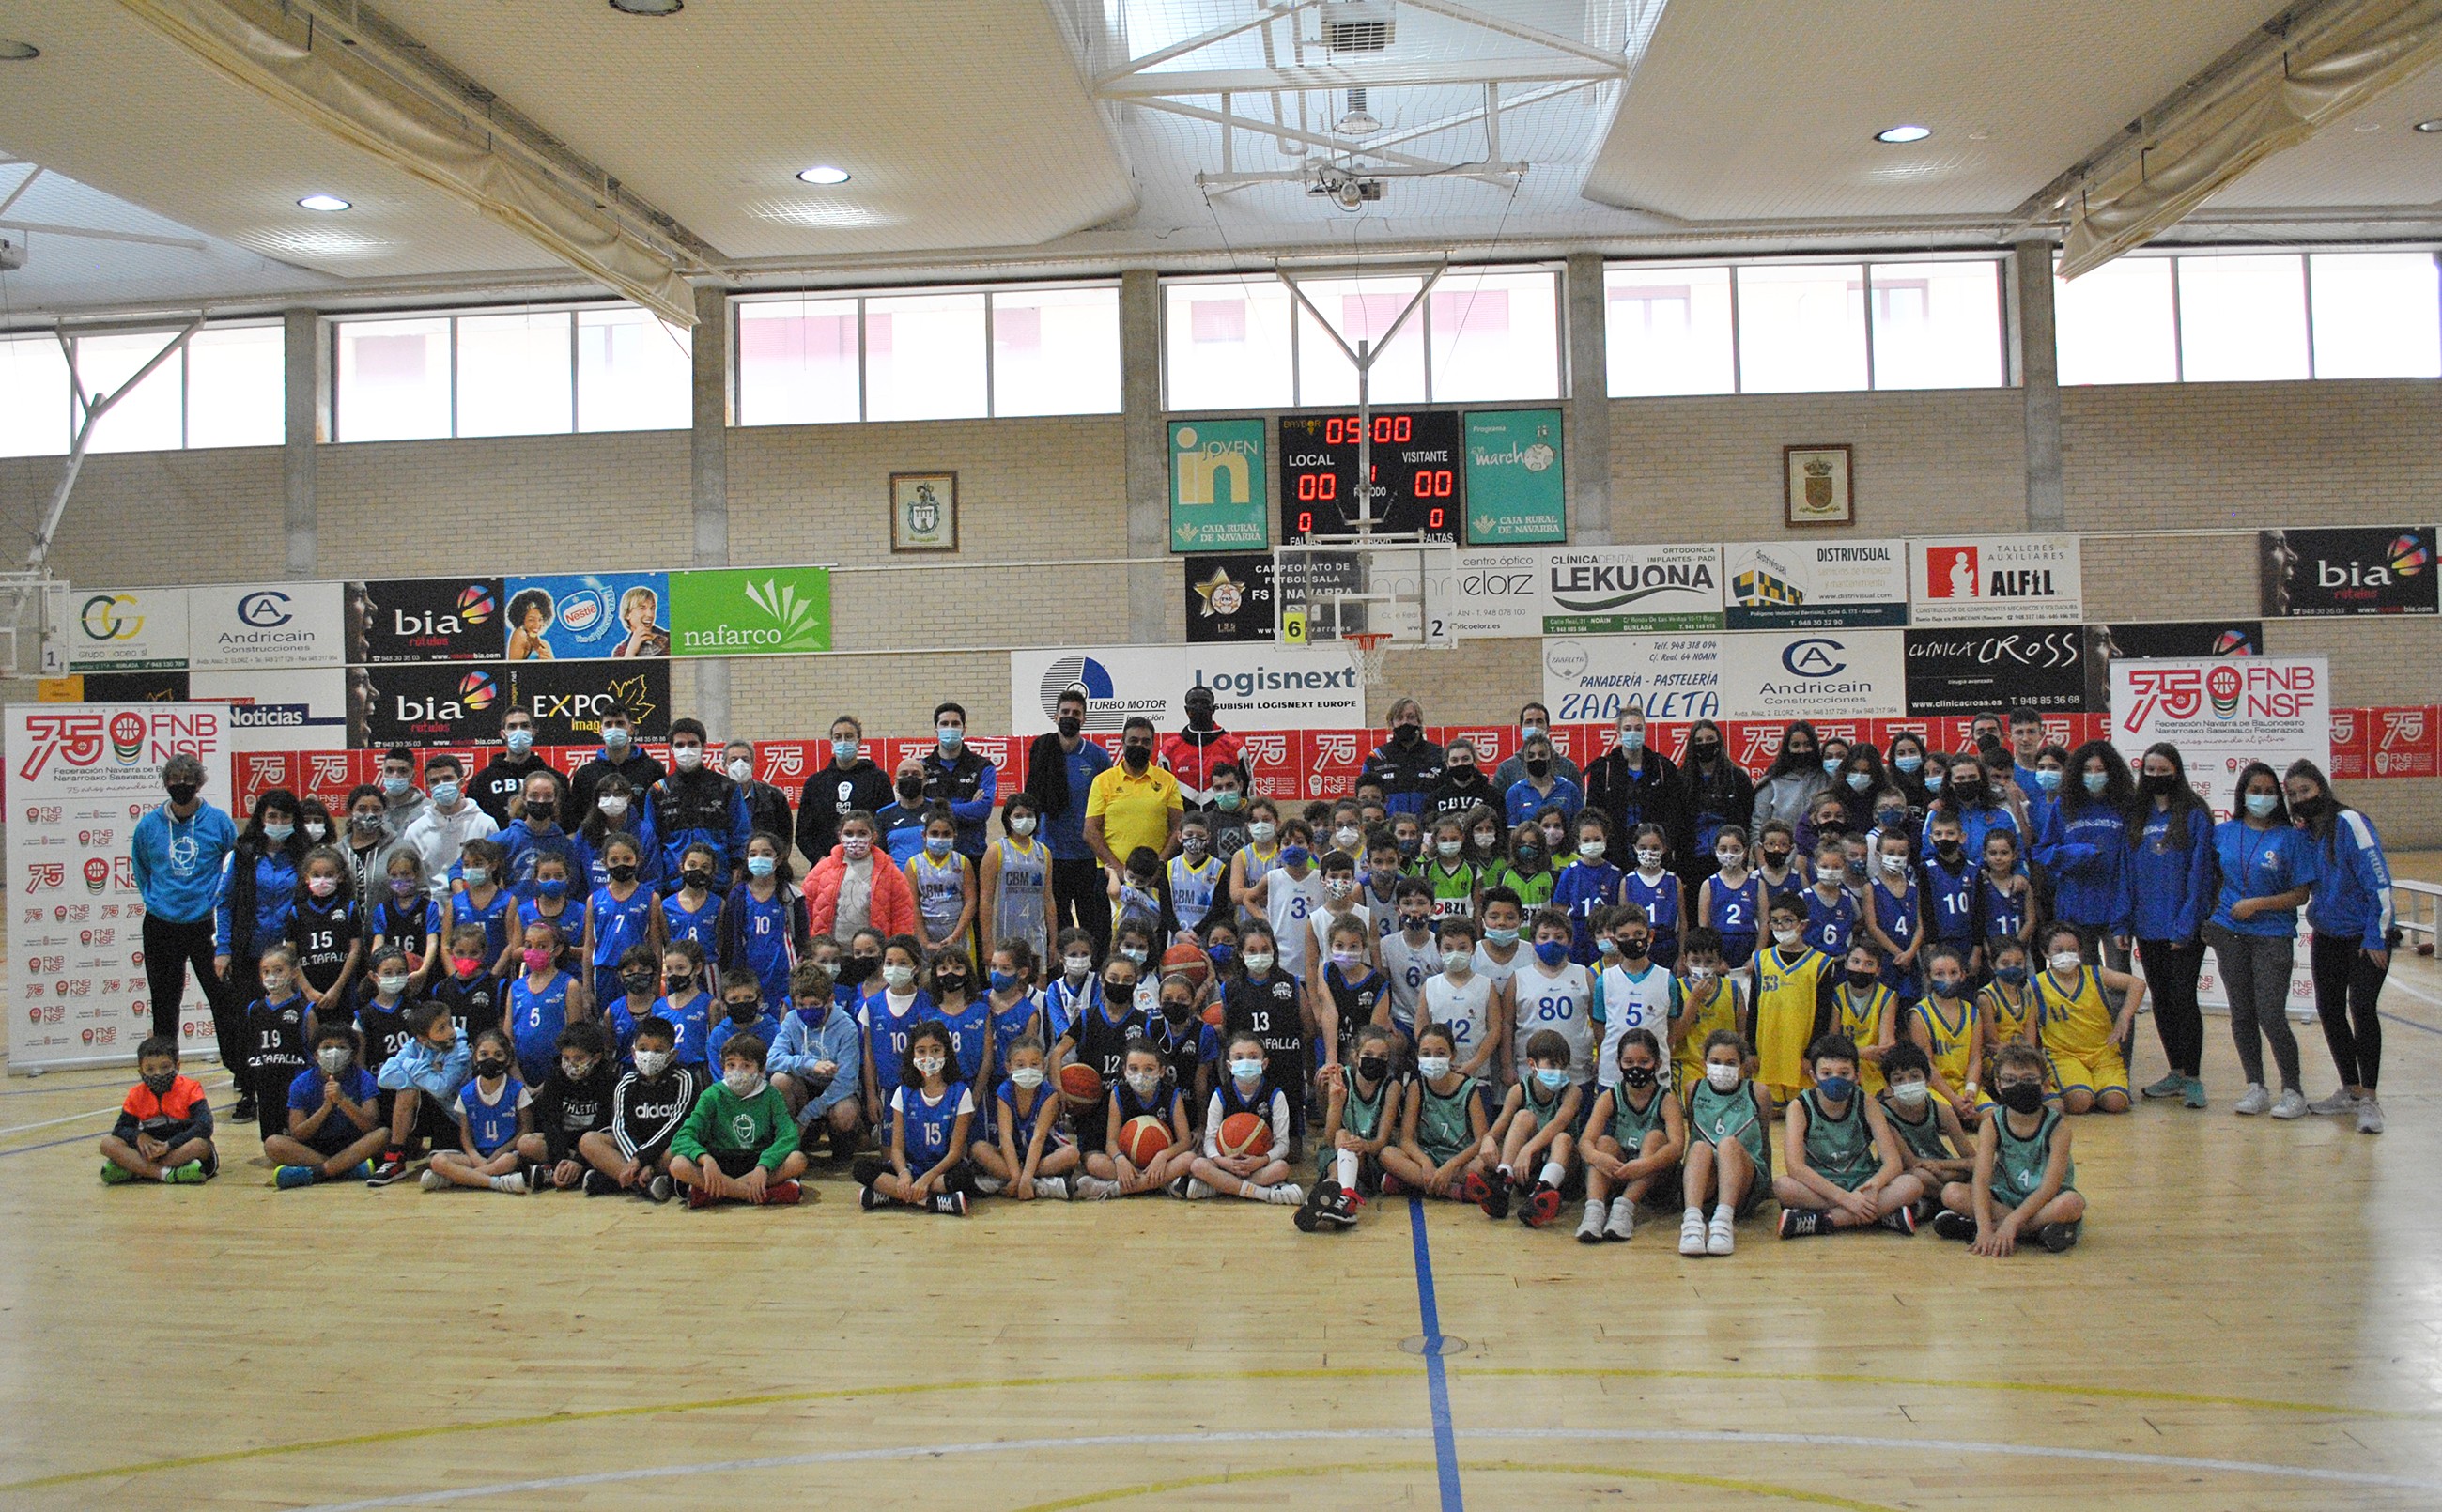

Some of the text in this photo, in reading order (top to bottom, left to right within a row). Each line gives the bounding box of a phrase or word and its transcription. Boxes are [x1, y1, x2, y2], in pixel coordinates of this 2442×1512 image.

[1473, 425, 1507, 434] Programa
[1203, 440, 1258, 461] JOVEN
[1402, 451, 1448, 463] VISITANTE
[1289, 455, 1335, 467] LOCAL
[1298, 473, 1337, 501] 00
[1414, 471, 1453, 498] 00
[1298, 512, 1312, 532] 0
[1430, 508, 1444, 528] 0
[1500, 517, 1522, 525] CAJA
[1200, 532, 1261, 542] DE NAVARRA
[1228, 524, 1260, 532] RURAL
[1515, 525, 1560, 533] NAVARRA
[1462, 556, 1533, 568] centro óptico
[1817, 548, 1890, 562] DISTRIVISUAL
[1988, 552, 2063, 561] AUXILIARES
[1463, 570, 1534, 595] elorz
[1551, 564, 1715, 593] LEKUONA
[2318, 560, 2393, 587] bia
[1252, 590, 1269, 600] FS
[395, 609, 463, 636] bia
[1288, 621, 1301, 637] 6
[1431, 619, 1444, 636] 2
[218, 630, 315, 643] Andricain
[684, 624, 781, 646] nafarco
[79, 650, 105, 659] Grupo
[223, 645, 310, 654] Construcciones
[47, 652, 56, 667] 1
[1196, 667, 1355, 697] Logisnext
[1579, 671, 1718, 687] PANADERÍA PASTELERÍA
[1759, 681, 1871, 694] Andricain
[2247, 667, 2315, 691] FNB
[397, 695, 465, 721] bia
[1090, 700, 1167, 710] TURBO MOTOR
[1558, 691, 1719, 720] ZABALETA
[1764, 696, 1866, 704] Construcciones
[1912, 700, 2002, 708] www.clinicacross.es
[2010, 697, 2017, 705] T.
[2020, 697, 2038, 705] 948
[2054, 696, 2065, 704] 36
[2068, 696, 2080, 704] 68
[2124, 670, 2202, 734] 75
[2248, 694, 2314, 717] NSF
[151, 714, 218, 737] FNB
[2380, 712, 2423, 750] 75
[19, 715, 104, 782] 75
[151, 740, 217, 764] NSF
[1313, 734, 1357, 773] 75
[2390, 753, 2412, 762] FNB
[247, 756, 286, 792] 75
[762, 746, 804, 784] 75
[2390, 763, 2412, 771] NSF
[1324, 776, 1346, 785] FNB
[1324, 785, 1346, 794] NSF
[25, 863, 64, 894] 75
[1005, 872, 1029, 887] CBM
[1019, 904, 1029, 919] 4
[1291, 897, 1306, 919] 3
[1445, 902, 1467, 917] BZK
[1943, 891, 1968, 914] 10
[615, 914, 626, 933] 7
[1726, 904, 1740, 924] 2
[754, 916, 770, 934] 10
[1823, 924, 1837, 945] 6
[1894, 915, 1908, 935] 4
[1996, 916, 2020, 935] 11
[311, 932, 332, 949] 15
[1406, 966, 1420, 987] 6
[530, 1008, 541, 1028] 5
[1538, 996, 1573, 1021] 80
[1626, 1002, 1642, 1026] 5
[1251, 1011, 1270, 1032] 13
[260, 1030, 282, 1049] 19
[384, 1031, 410, 1054] 20
[890, 1032, 907, 1052] 10
[1104, 1055, 1121, 1073] 12
[486, 1120, 498, 1141] 4
[923, 1123, 941, 1144] 15
[1440, 1122, 1448, 1137] 7
[1714, 1117, 1725, 1134] 6
[2017, 1169, 2030, 1186] 4
